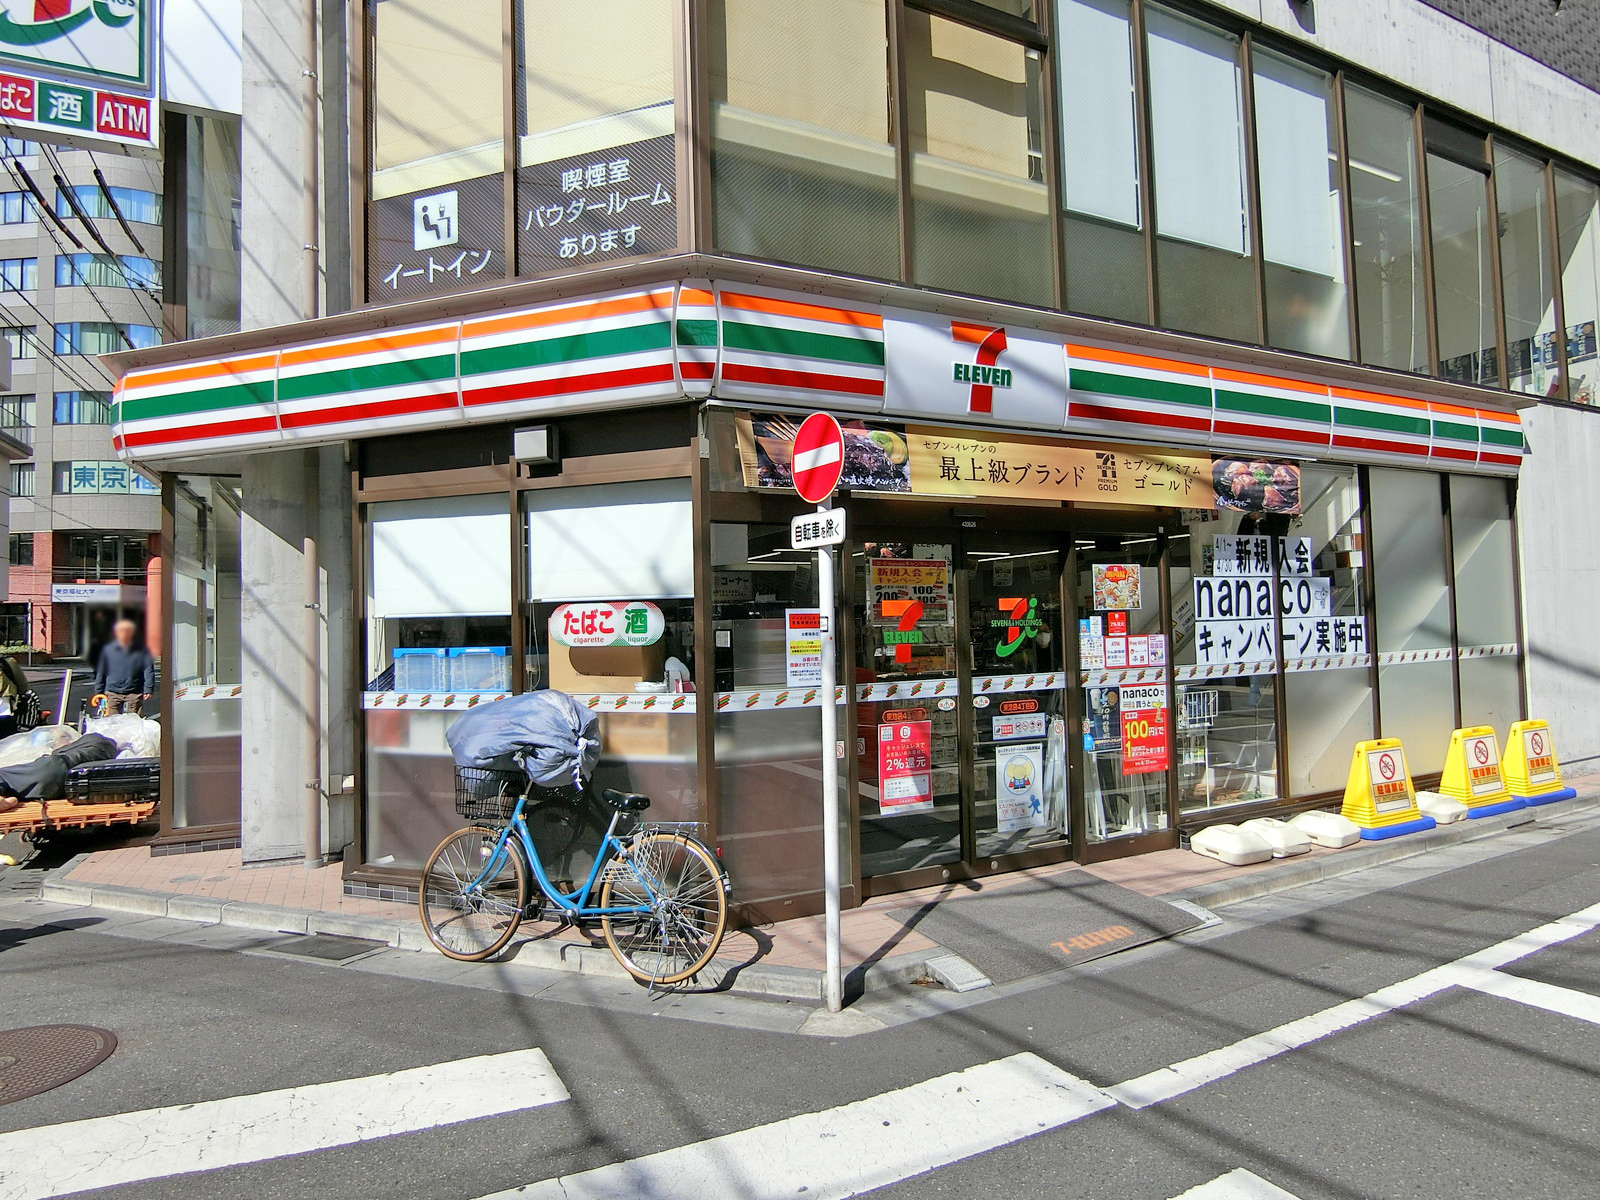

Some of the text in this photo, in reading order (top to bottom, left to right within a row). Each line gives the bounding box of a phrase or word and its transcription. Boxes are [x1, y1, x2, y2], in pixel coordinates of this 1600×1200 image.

[50, 90, 83, 122] 酒
[100, 101, 147, 134] ATM
[562, 158, 631, 194] 喫煙室
[525, 182, 672, 231] パウダールーム
[559, 224, 642, 259] あります
[383, 249, 492, 290] イートイン
[939, 455, 1086, 488] 最上級ブランド
[1123, 458, 1201, 476] セブンプレミアム
[1097, 484, 1118, 492] GOLD
[1134, 474, 1193, 495] ゴールド
[794, 518, 840, 543] 自転車を除く
[1235, 537, 1309, 574] 新規入会
[1196, 579, 1312, 618] nanaco
[563, 608, 648, 635] たばこ 酒
[1014, 618, 1043, 627] HOLDINGS
[573, 635, 649, 644] cigarette liquor
[1198, 617, 1363, 662] キャンペーン実施中
[886, 742, 926, 751] キャッシュレスで
[886, 756, 926, 771] 2%還元
